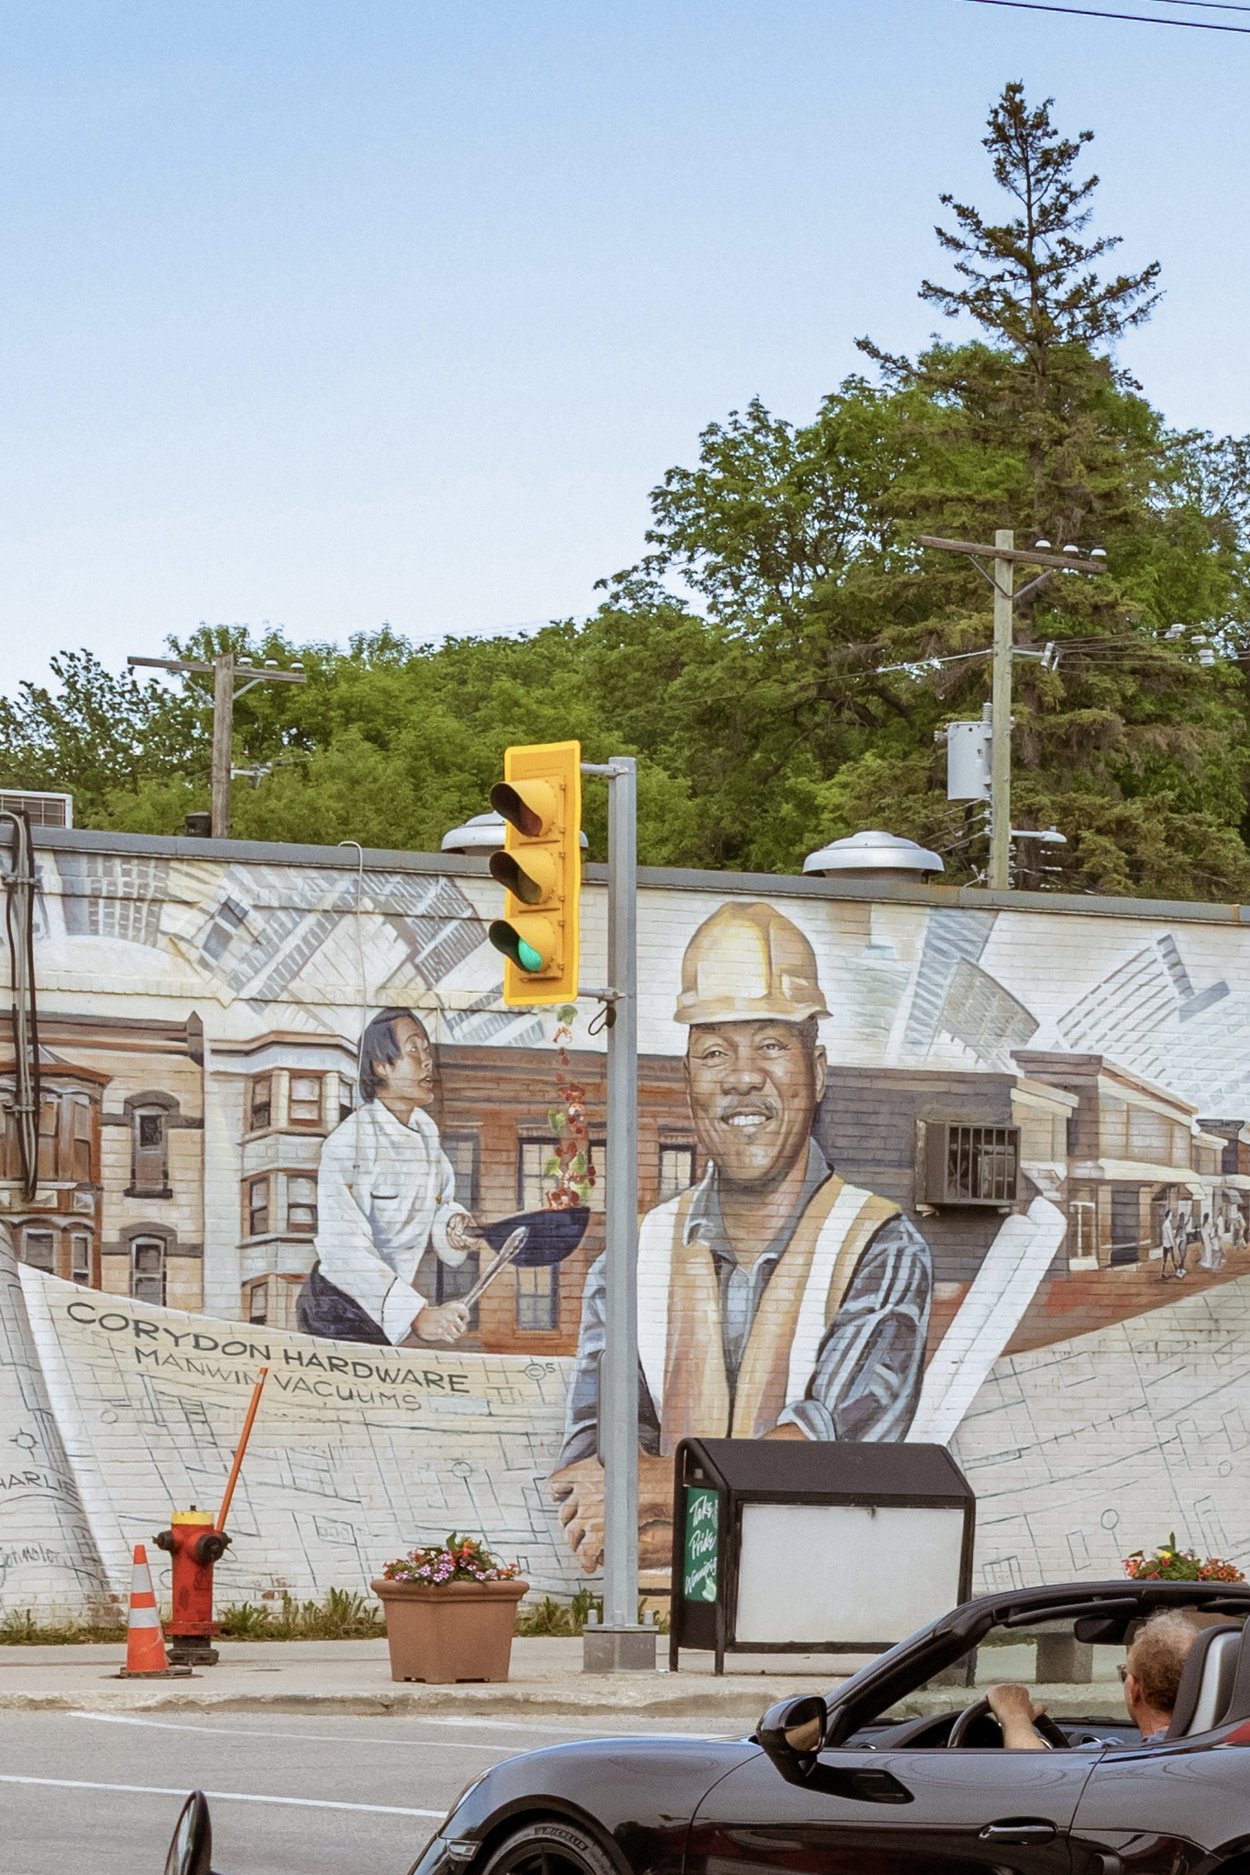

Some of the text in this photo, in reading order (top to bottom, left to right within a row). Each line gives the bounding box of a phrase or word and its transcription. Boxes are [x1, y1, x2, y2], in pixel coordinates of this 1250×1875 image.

[67, 1302, 470, 1393] CORYDON HARDWARE
[273, 1374, 422, 1411] VACUUMS
[689, 1495, 712, 1527] Take
[689, 1529, 716, 1559] Pride
